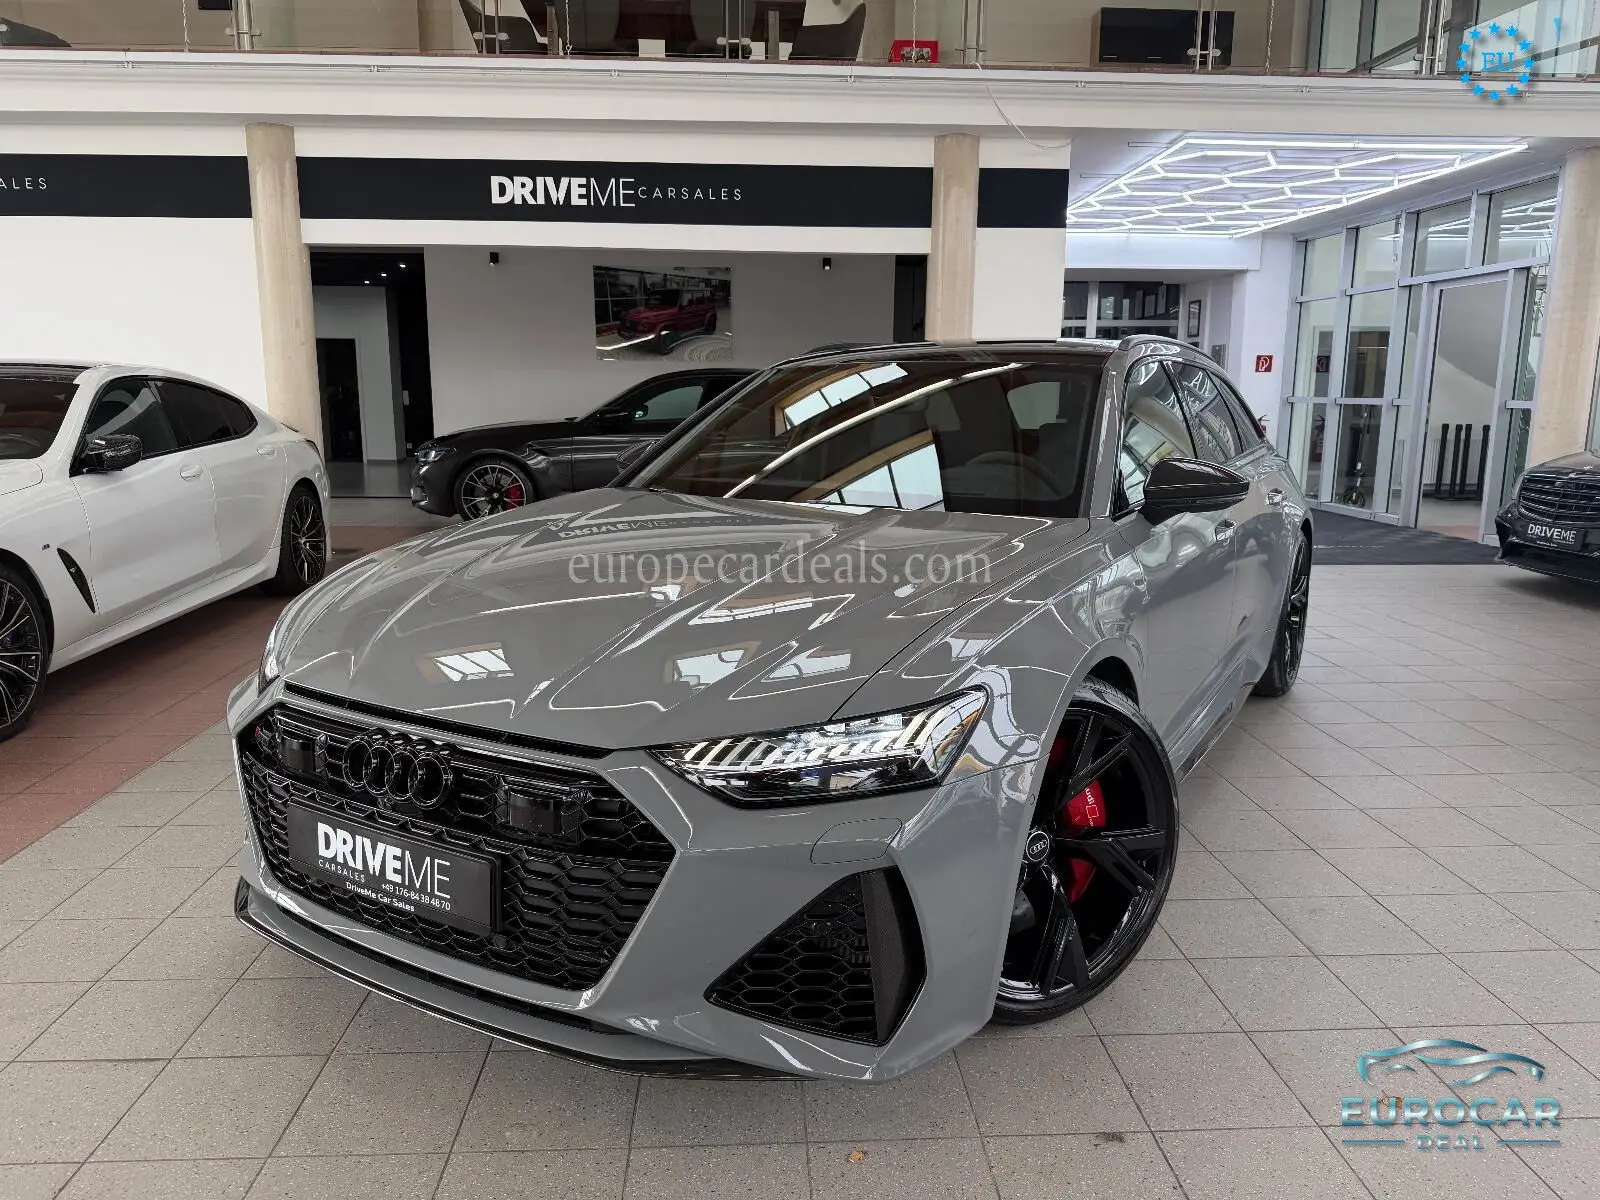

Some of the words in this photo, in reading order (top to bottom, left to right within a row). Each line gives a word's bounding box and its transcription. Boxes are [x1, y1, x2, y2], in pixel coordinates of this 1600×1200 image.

[490, 175, 636, 207] DRIVEME
[637, 186, 742, 201] CARSALES
[1527, 523, 1577, 542] DRIVEME
[317, 821, 450, 899] DRIVEME
[318, 859, 365, 883] CARSALES
[346, 881, 377, 899] DriveMe
[377, 893, 391, 904] Car
[392, 898, 415, 912] Sales
[441, 900, 451, 911] 70
